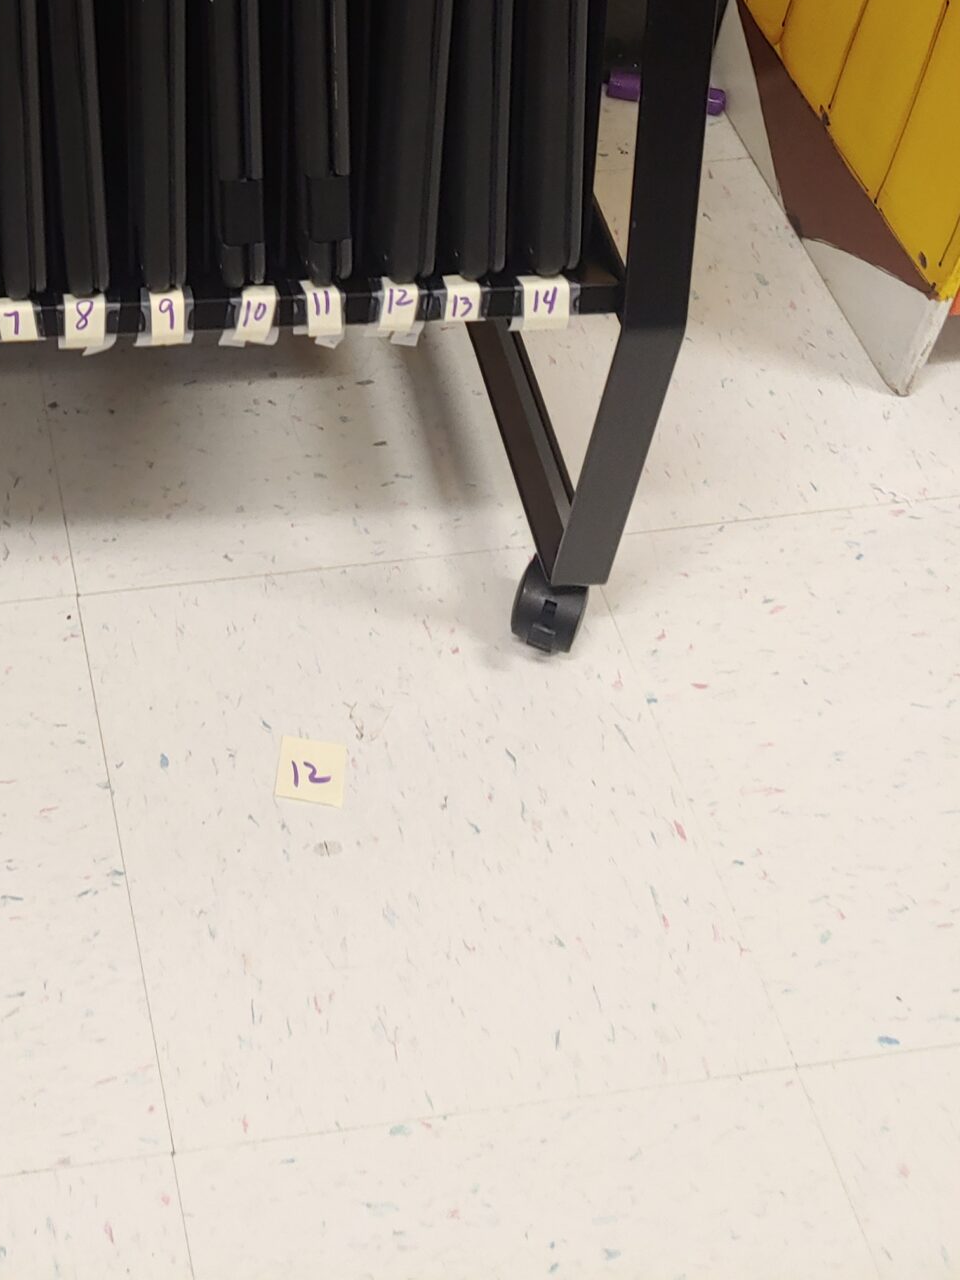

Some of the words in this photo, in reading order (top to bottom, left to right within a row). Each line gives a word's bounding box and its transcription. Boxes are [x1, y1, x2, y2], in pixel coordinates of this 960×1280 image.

[242, 300, 268, 326] 10
[313, 290, 332, 314] 11
[385, 288, 414, 313] 12
[451, 294, 475, 318] 13
[531, 287, 558, 313] 14
[4, 310, 22, 335] 7
[75, 301, 95, 329] 8
[157, 299, 177, 329] 9
[291, 760, 332, 788] 12
